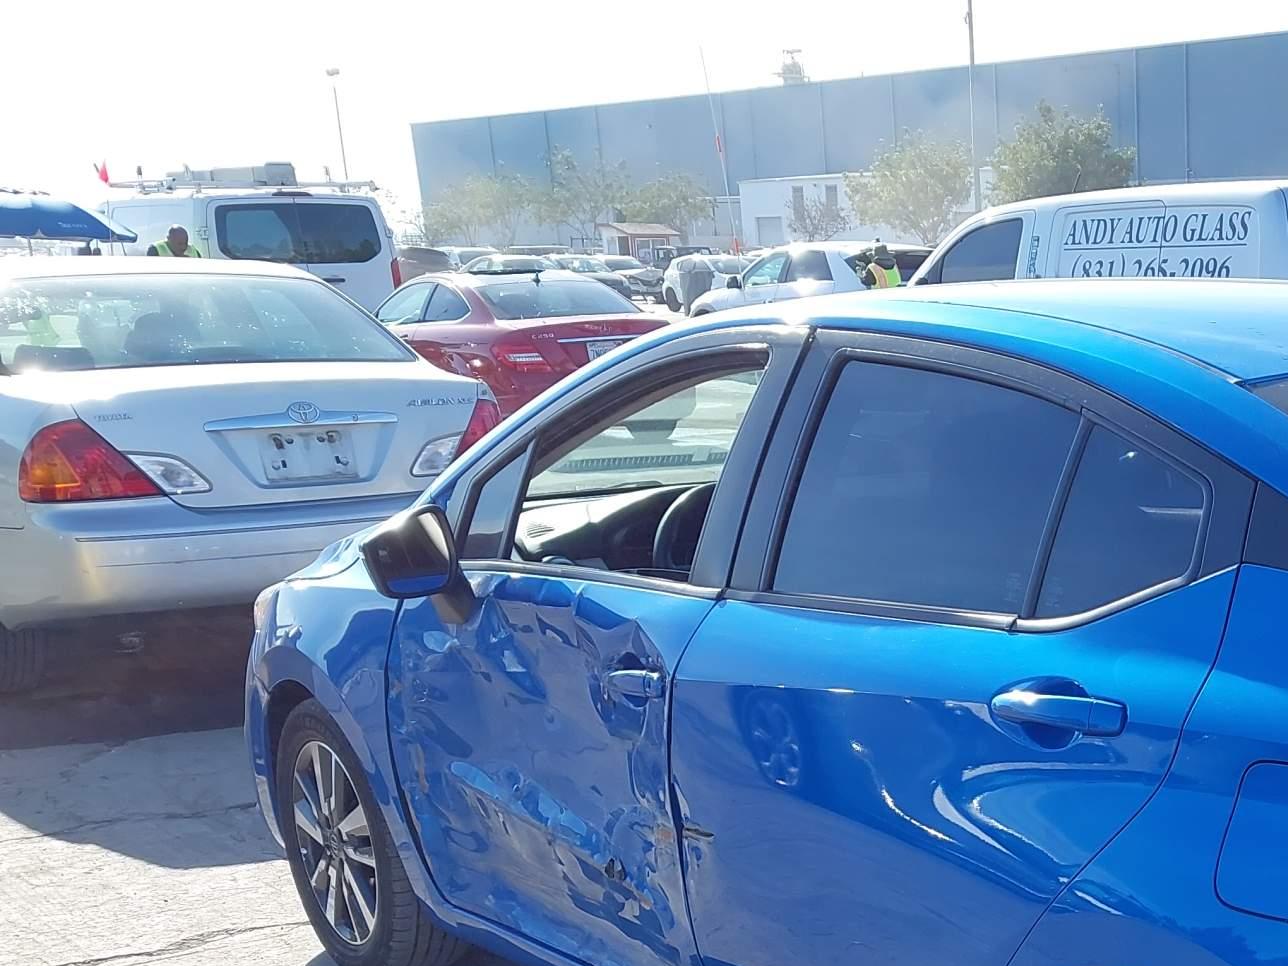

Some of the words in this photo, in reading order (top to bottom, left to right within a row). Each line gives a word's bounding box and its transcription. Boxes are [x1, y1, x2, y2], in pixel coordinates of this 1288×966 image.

[1064, 217, 1122, 246] ANDY
[1121, 214, 1178, 244] AUTO
[1183, 210, 1252, 243] GLASS
